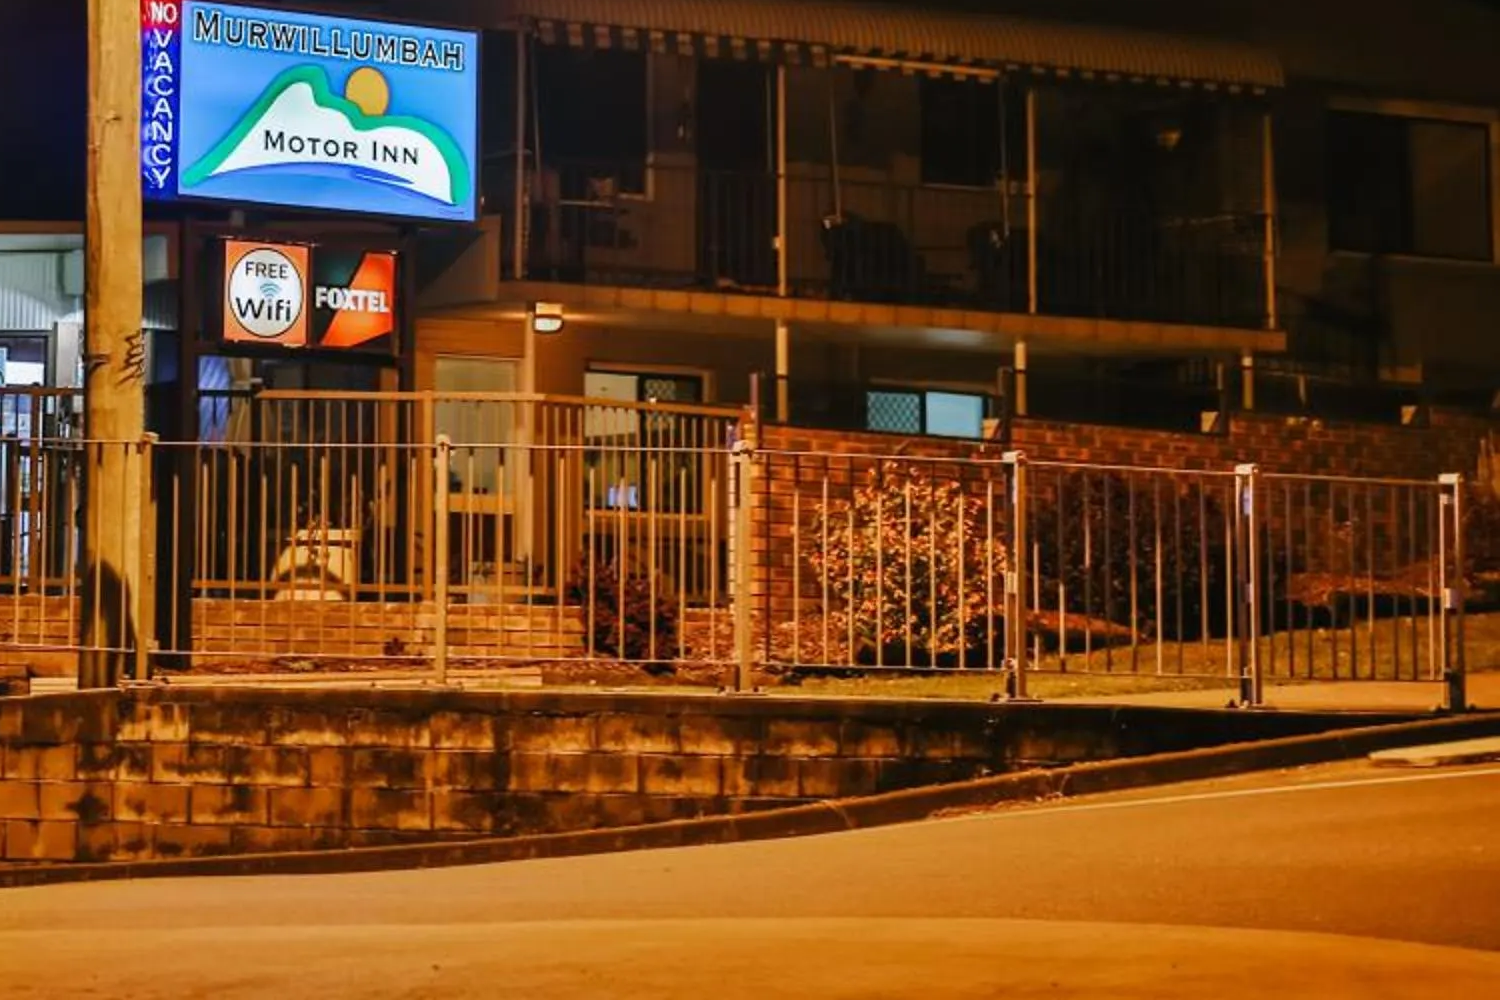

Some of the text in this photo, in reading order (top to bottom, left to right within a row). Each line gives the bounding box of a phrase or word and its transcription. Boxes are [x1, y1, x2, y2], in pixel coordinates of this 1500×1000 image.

[150, 1, 177, 24] NO
[194, 8, 465, 71] MURWILLUMBAH
[151, 28, 174, 189] VACANCY
[263, 129, 419, 165] MOTOR INN
[245, 260, 290, 280] FREE
[235, 297, 292, 322] Wifi
[315, 286, 390, 313] FOXTEL
